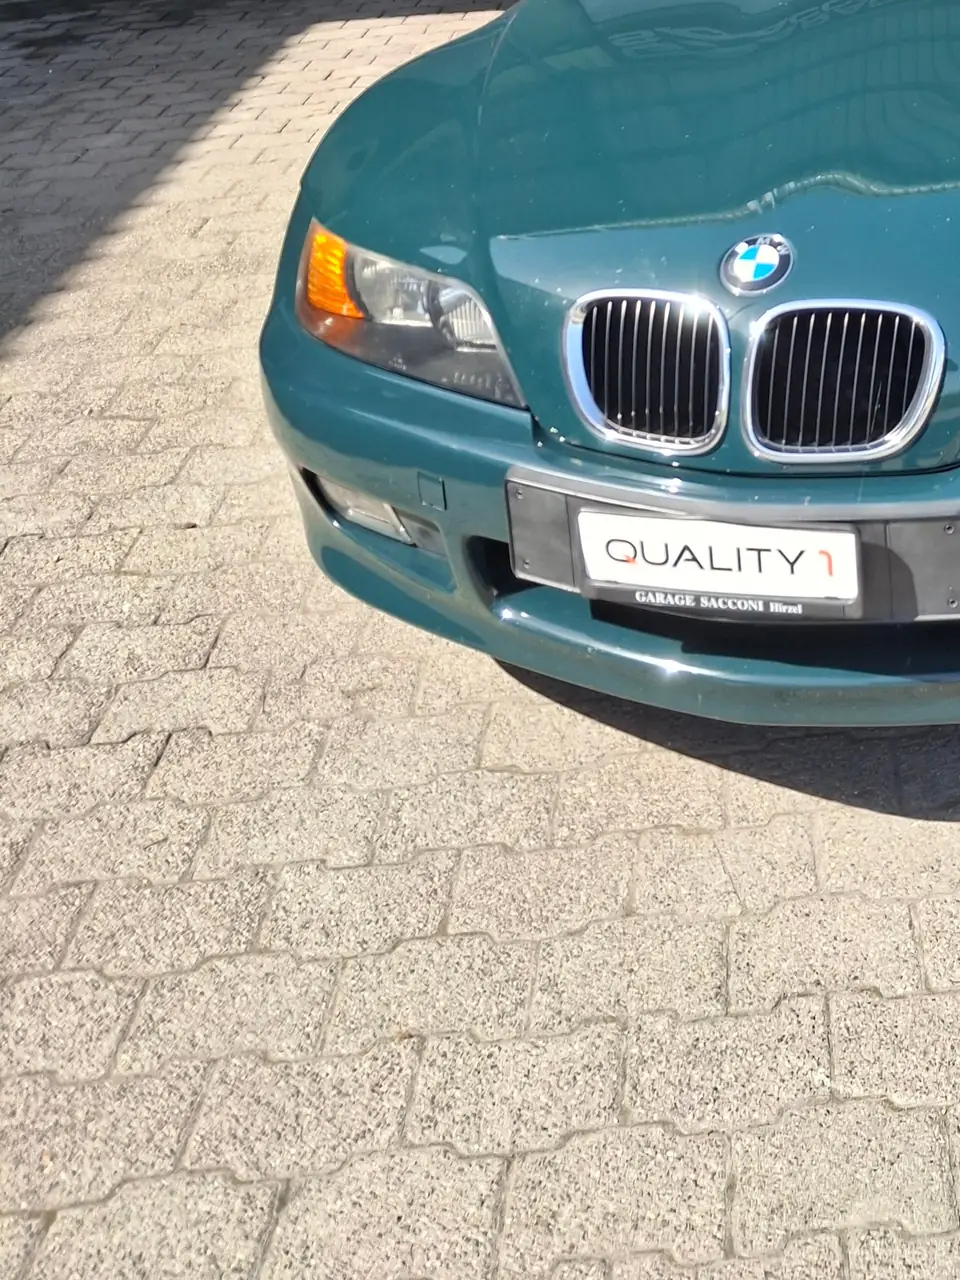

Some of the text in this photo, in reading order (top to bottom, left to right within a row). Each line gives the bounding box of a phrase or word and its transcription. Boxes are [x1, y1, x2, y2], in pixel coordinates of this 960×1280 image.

[635, 590, 803, 614] GARAGE SACCONI Hirzel
